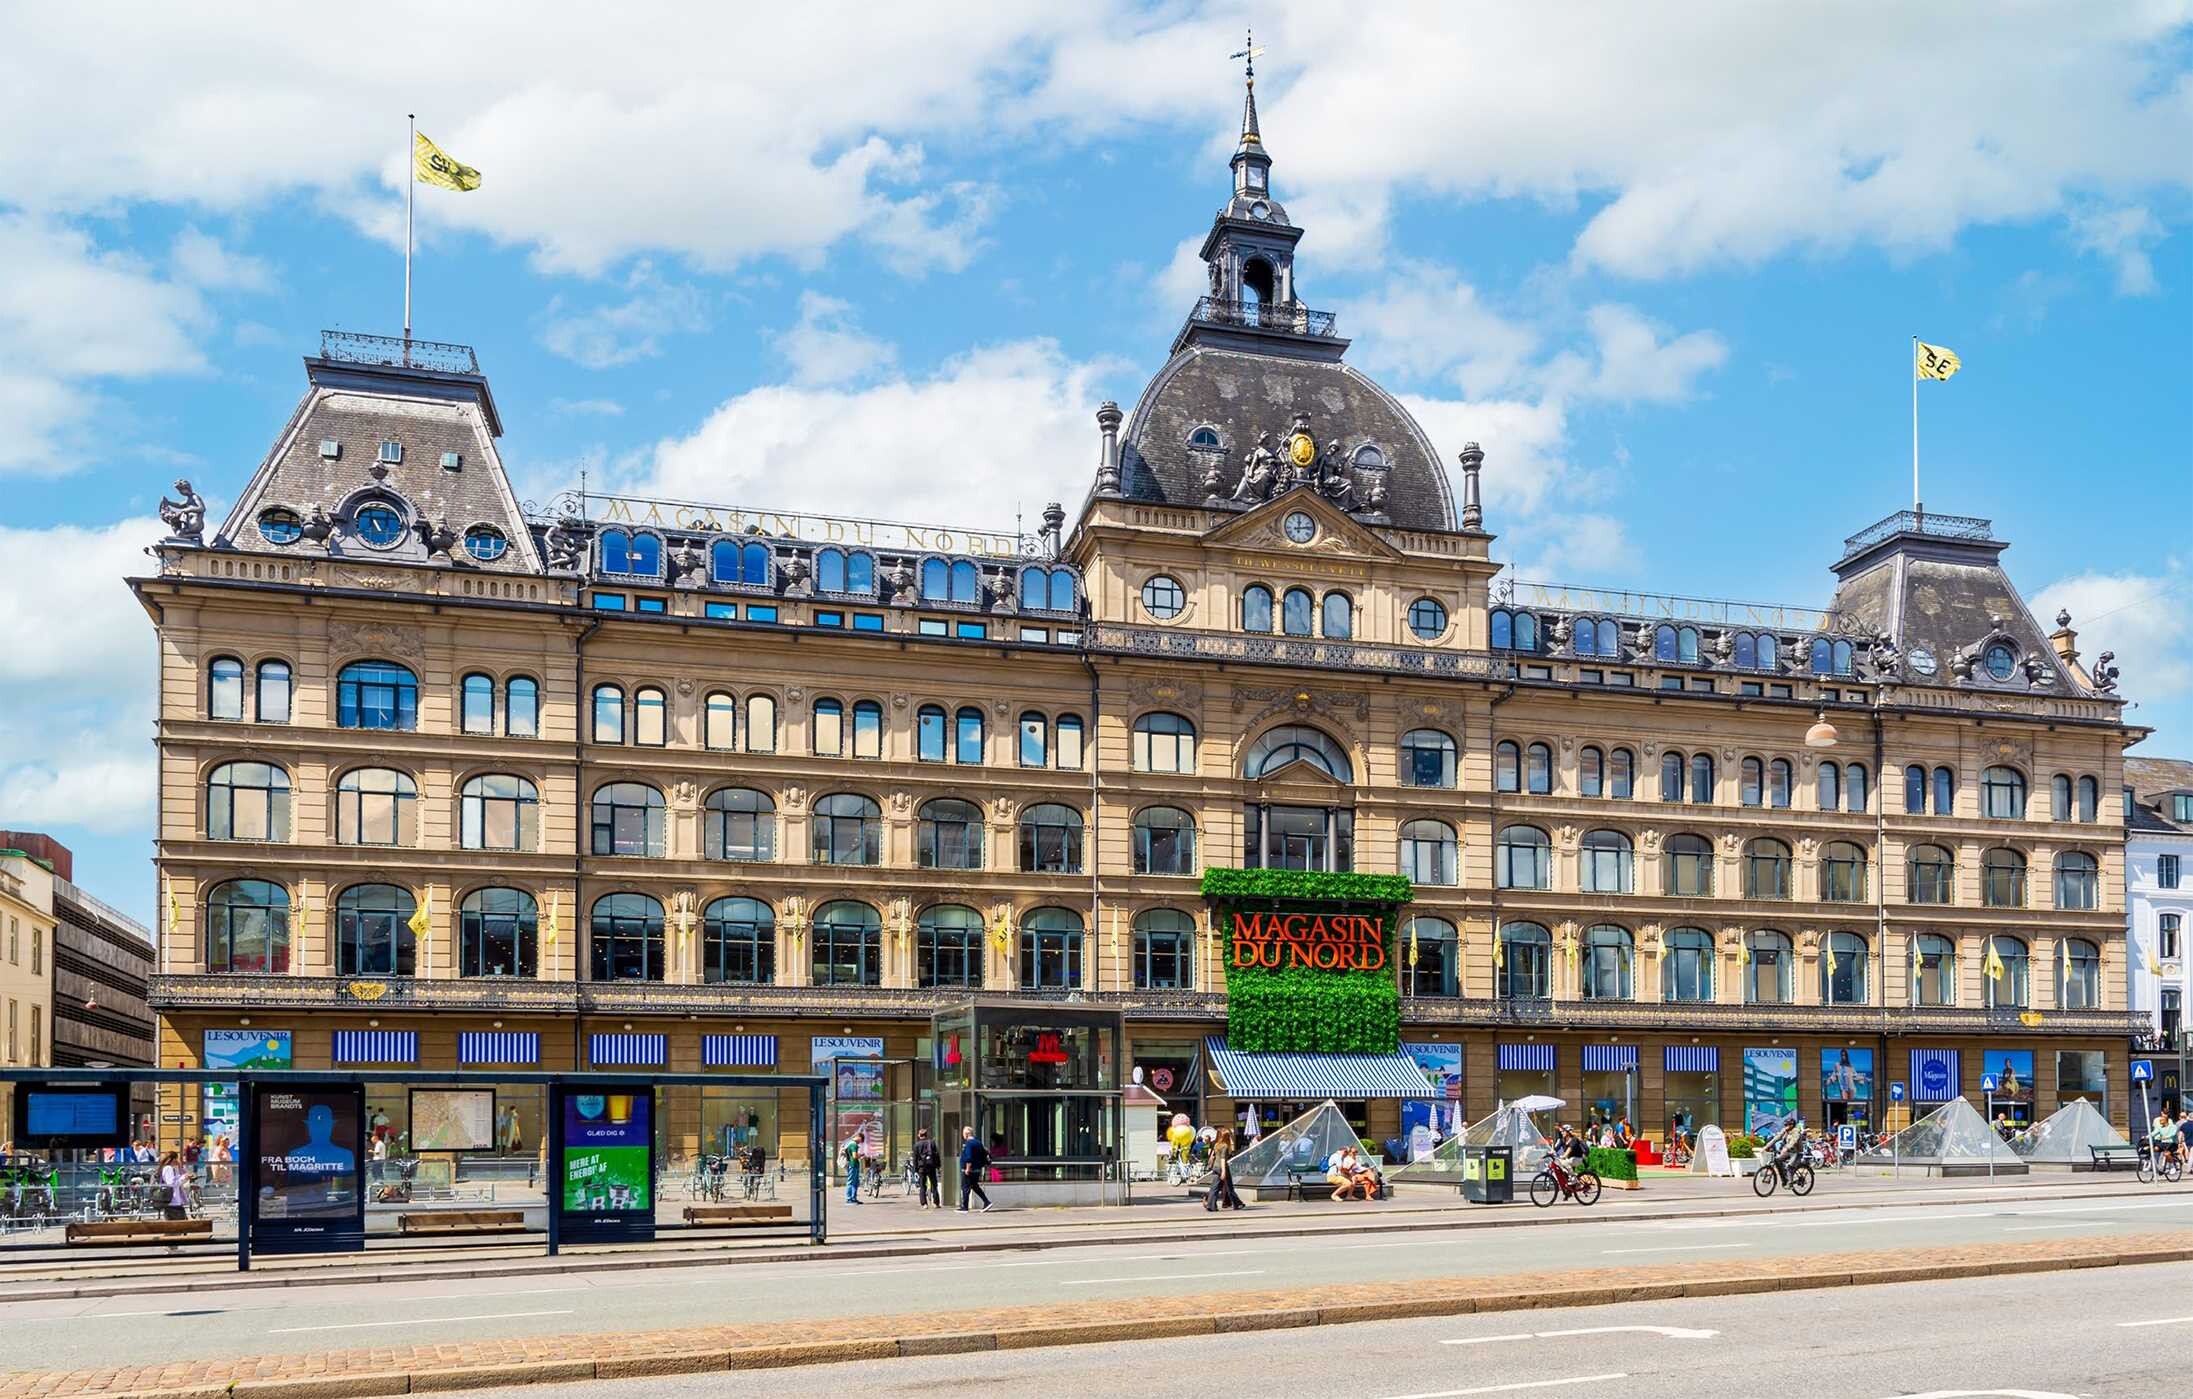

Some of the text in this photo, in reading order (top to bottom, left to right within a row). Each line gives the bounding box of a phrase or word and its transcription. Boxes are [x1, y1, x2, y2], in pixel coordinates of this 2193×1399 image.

[602, 500, 1011, 557] MAGASIN DU NORD
[1232, 912, 1383, 943] MAGASIN
[1232, 940, 1385, 969] DU NORD
[208, 1031, 288, 1040] LE SOUVENIR
[814, 1038, 880, 1048] LE SOUVENIR
[1416, 1045, 1459, 1054] SOUVENIR
[1843, 1128, 1852, 1141] P
[289, 1162, 344, 1171] MAGRITTE
